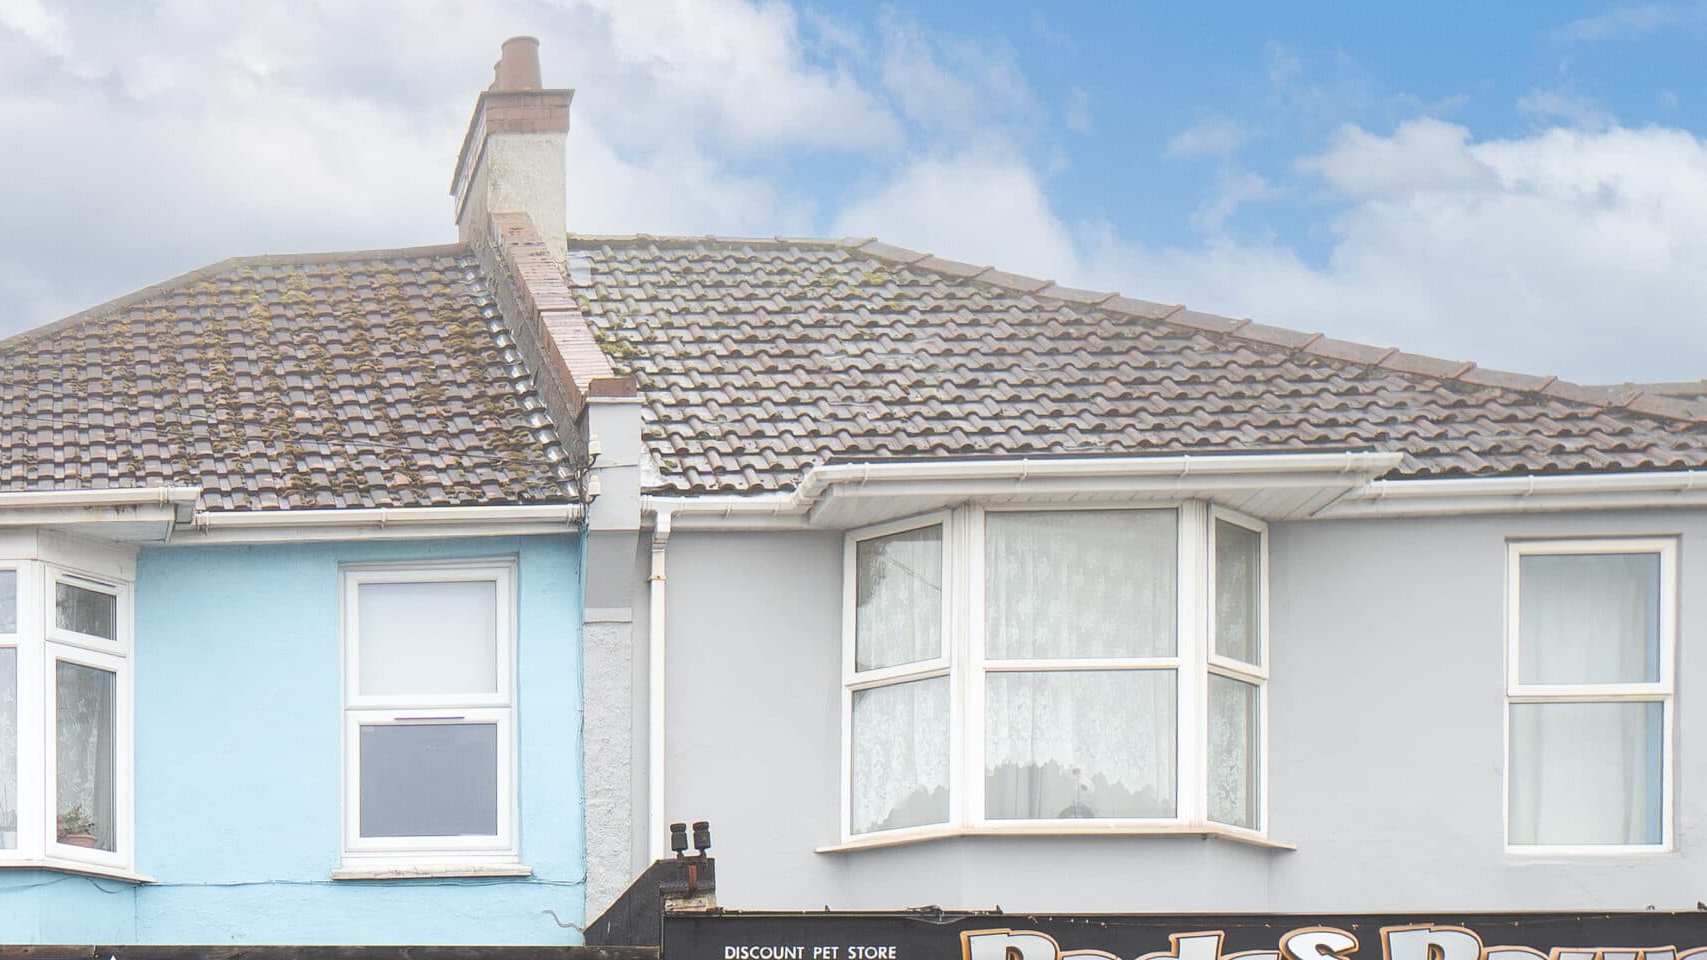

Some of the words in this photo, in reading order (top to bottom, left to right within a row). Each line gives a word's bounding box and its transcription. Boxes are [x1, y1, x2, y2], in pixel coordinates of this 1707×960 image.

[723, 944, 806, 960] DISCOUNT
[812, 945, 835, 960] PET
[840, 945, 897, 960] STORE
